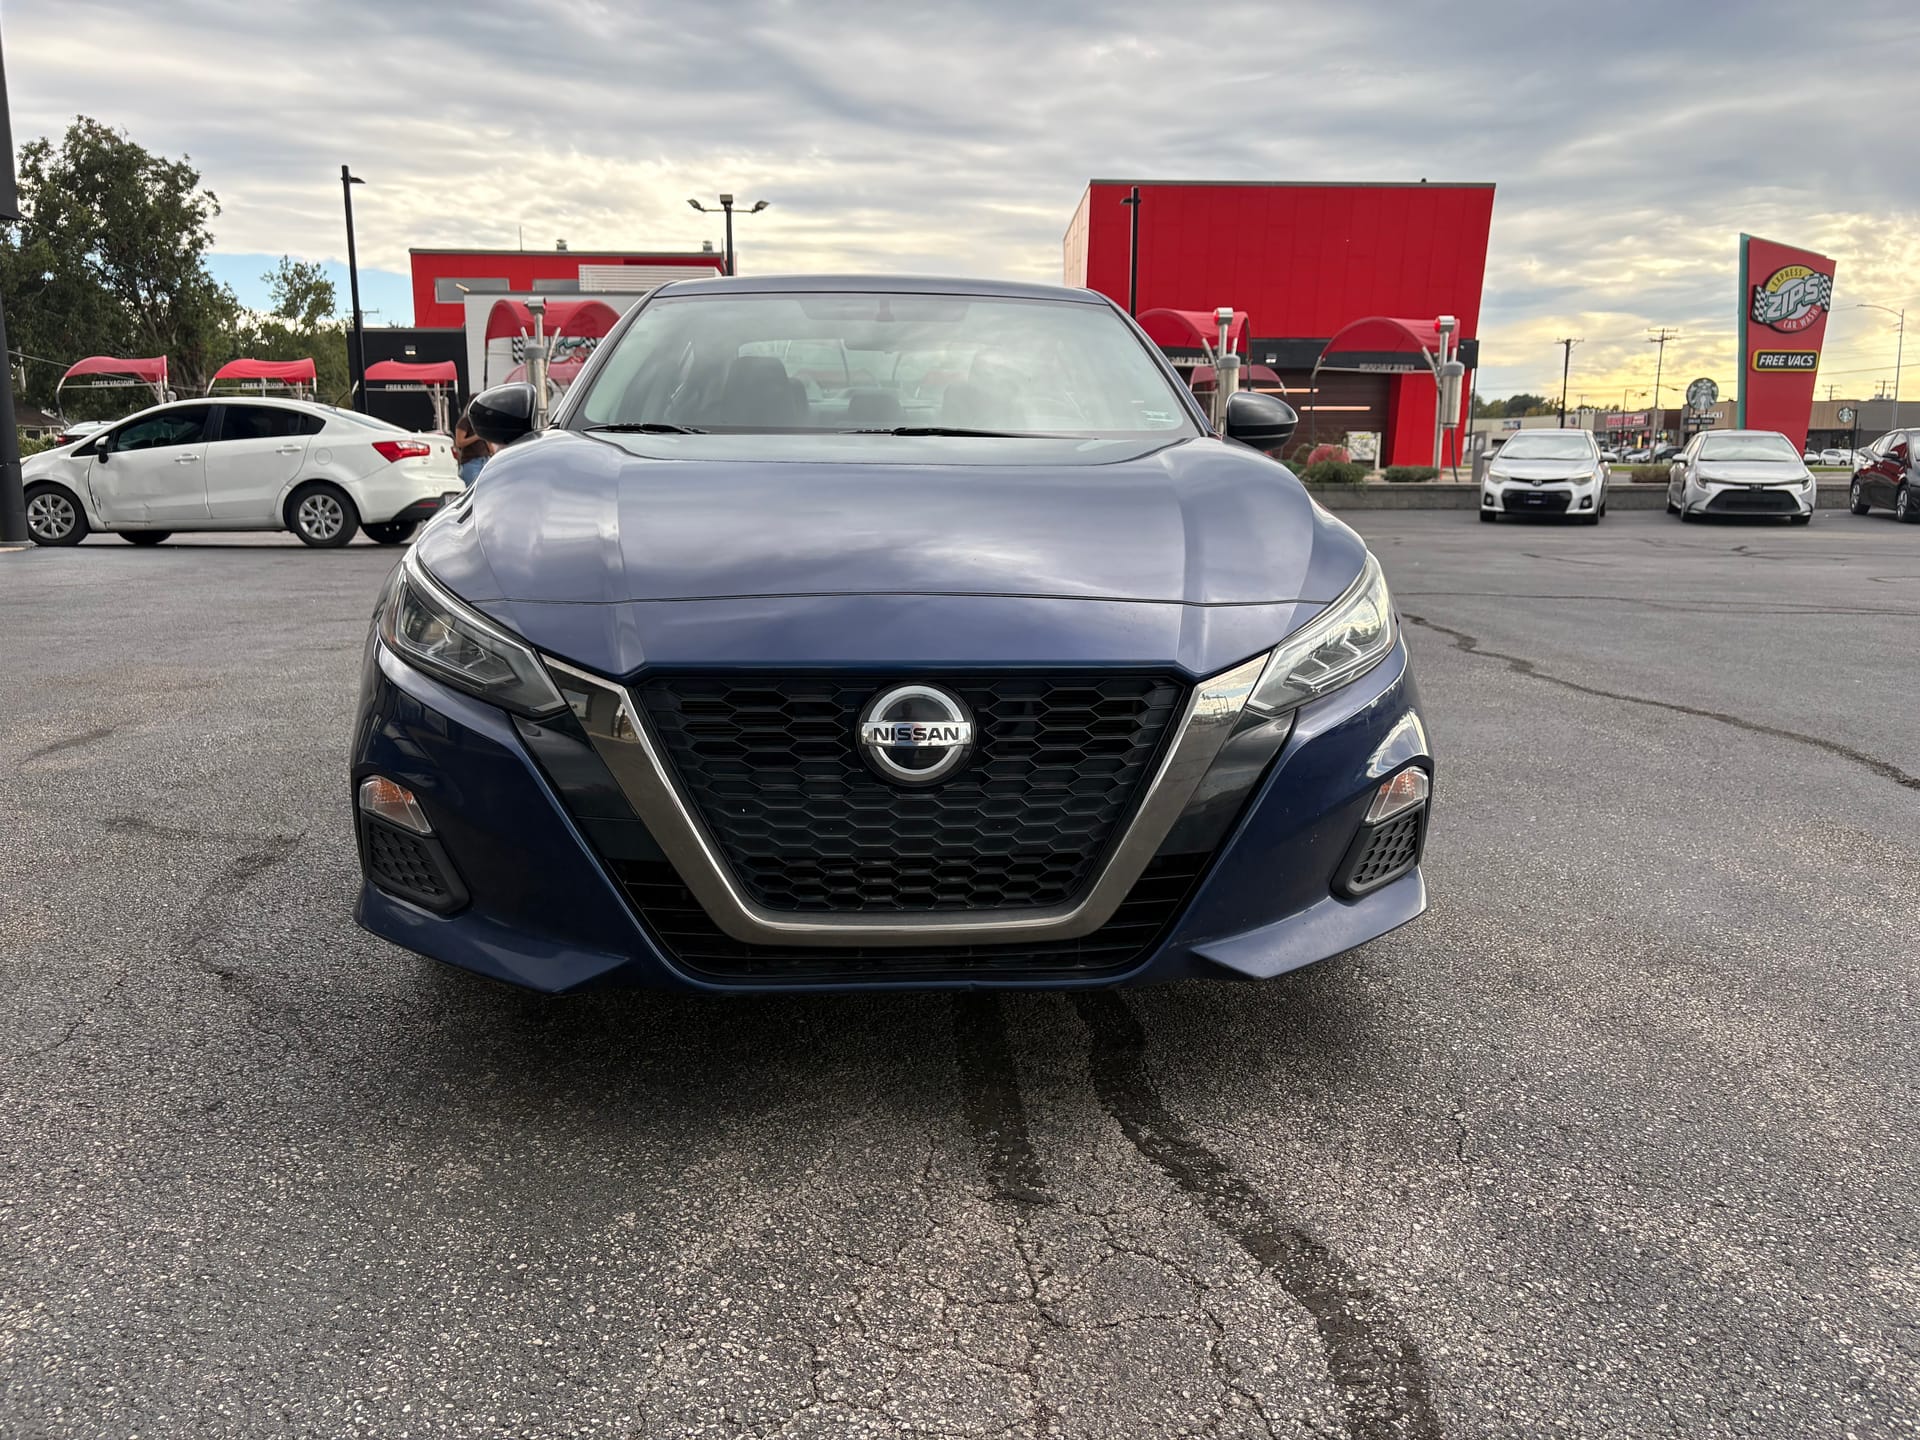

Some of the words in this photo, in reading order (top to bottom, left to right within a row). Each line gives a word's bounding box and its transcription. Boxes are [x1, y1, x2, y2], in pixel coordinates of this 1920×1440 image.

[1772, 268, 1802, 287] EXPRESS
[1766, 276, 1819, 318] ZIPS
[1783, 320, 1797, 329] CAR
[1800, 308, 1818, 327] WASH
[1759, 355, 1786, 366] FREE
[1788, 355, 1814, 366] VACS
[873, 727, 959, 741] NISSAN
